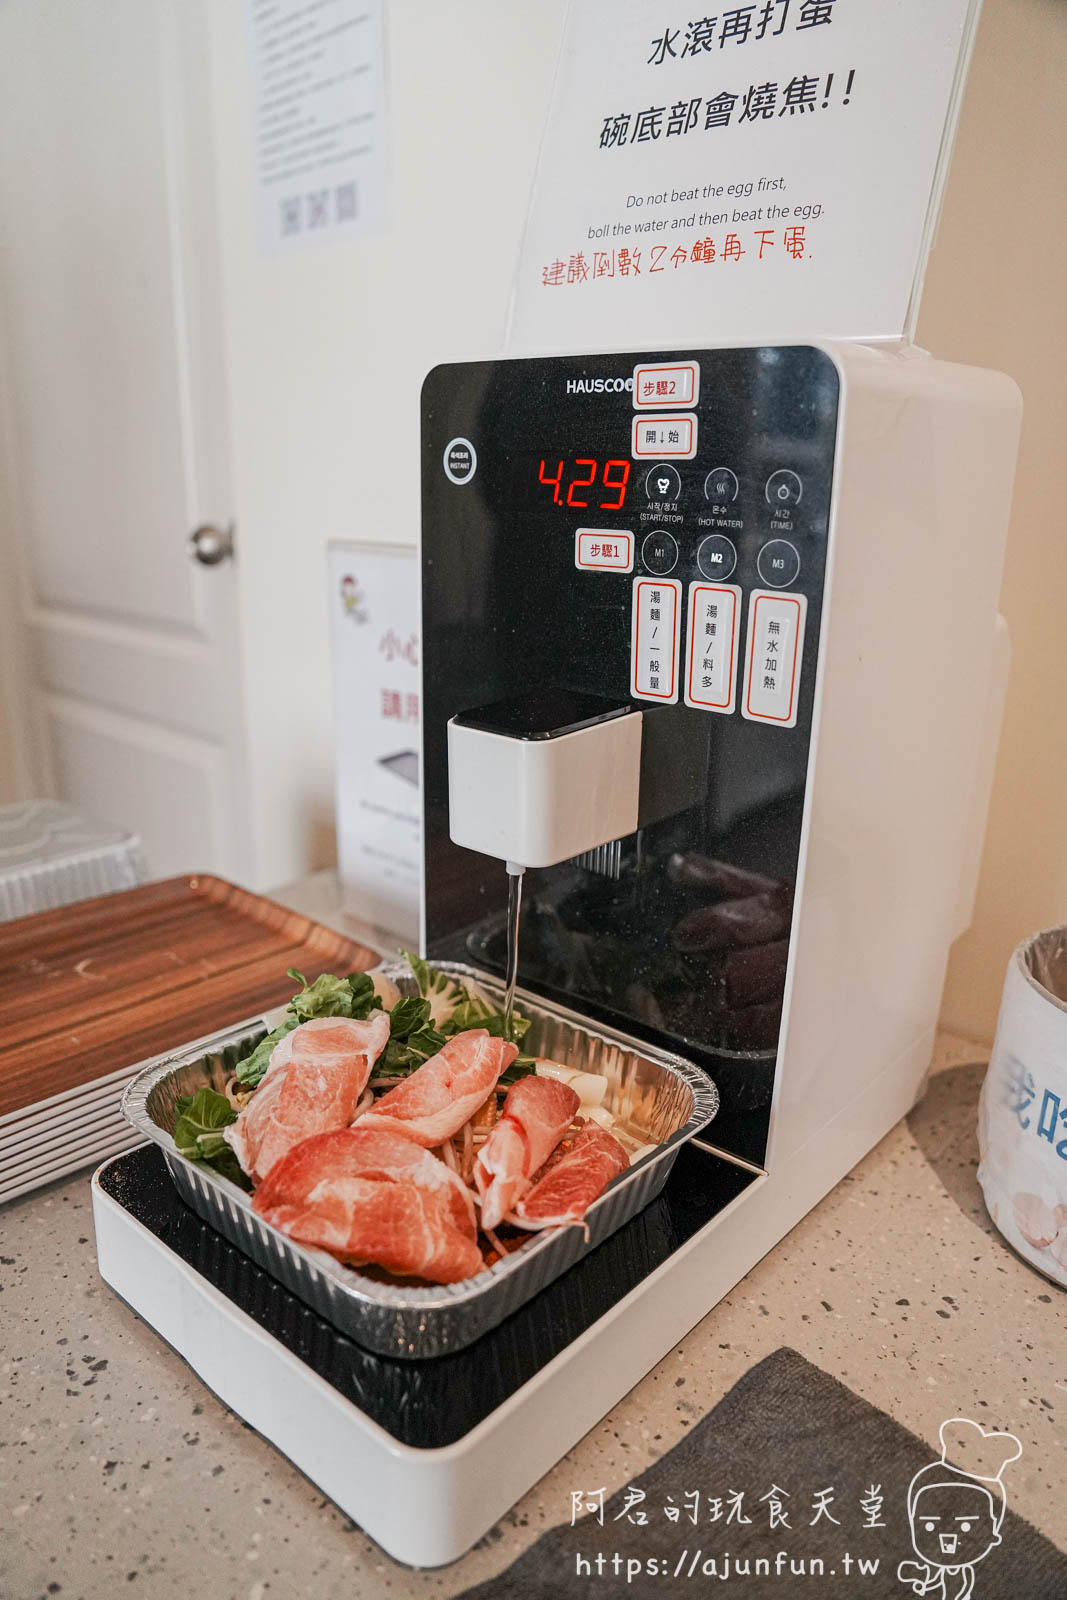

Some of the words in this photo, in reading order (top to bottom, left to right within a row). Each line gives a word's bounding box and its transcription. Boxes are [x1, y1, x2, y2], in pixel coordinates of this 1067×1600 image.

[647, 0, 836, 65] 水滾再打蛋
[599, 69, 856, 149] 碗底部會燒焦!!
[626, 196, 643, 208] Do
[646, 192, 668, 205] not
[671, 187, 698, 202] beat
[702, 184, 724, 199] the
[727, 182, 753, 197] egg
[757, 177, 787, 193] first,
[613, 222, 631, 236] the
[634, 219, 669, 233] water
[671, 214, 695, 229] and
[699, 210, 728, 226] then
[732, 207, 762, 223] beat
[766, 204, 790, 219] the
[793, 203, 825, 218] egg.
[643, 381, 676, 396] 步驟2
[450, 462, 470, 470] INSTANT
[539, 458, 630, 509] 4.29
[712, 506, 728, 514] 온수
[640, 513, 684, 523] (START/STOP)
[698, 518, 716, 527] (HOT
[717, 519, 743, 528] WATER)
[590, 544, 620, 558] 步驟1
[654, 548, 664, 558] M1
[711, 553, 723, 563] M2
[772, 559, 784, 569] M3
[763, 621, 780, 690] 無水加熱
